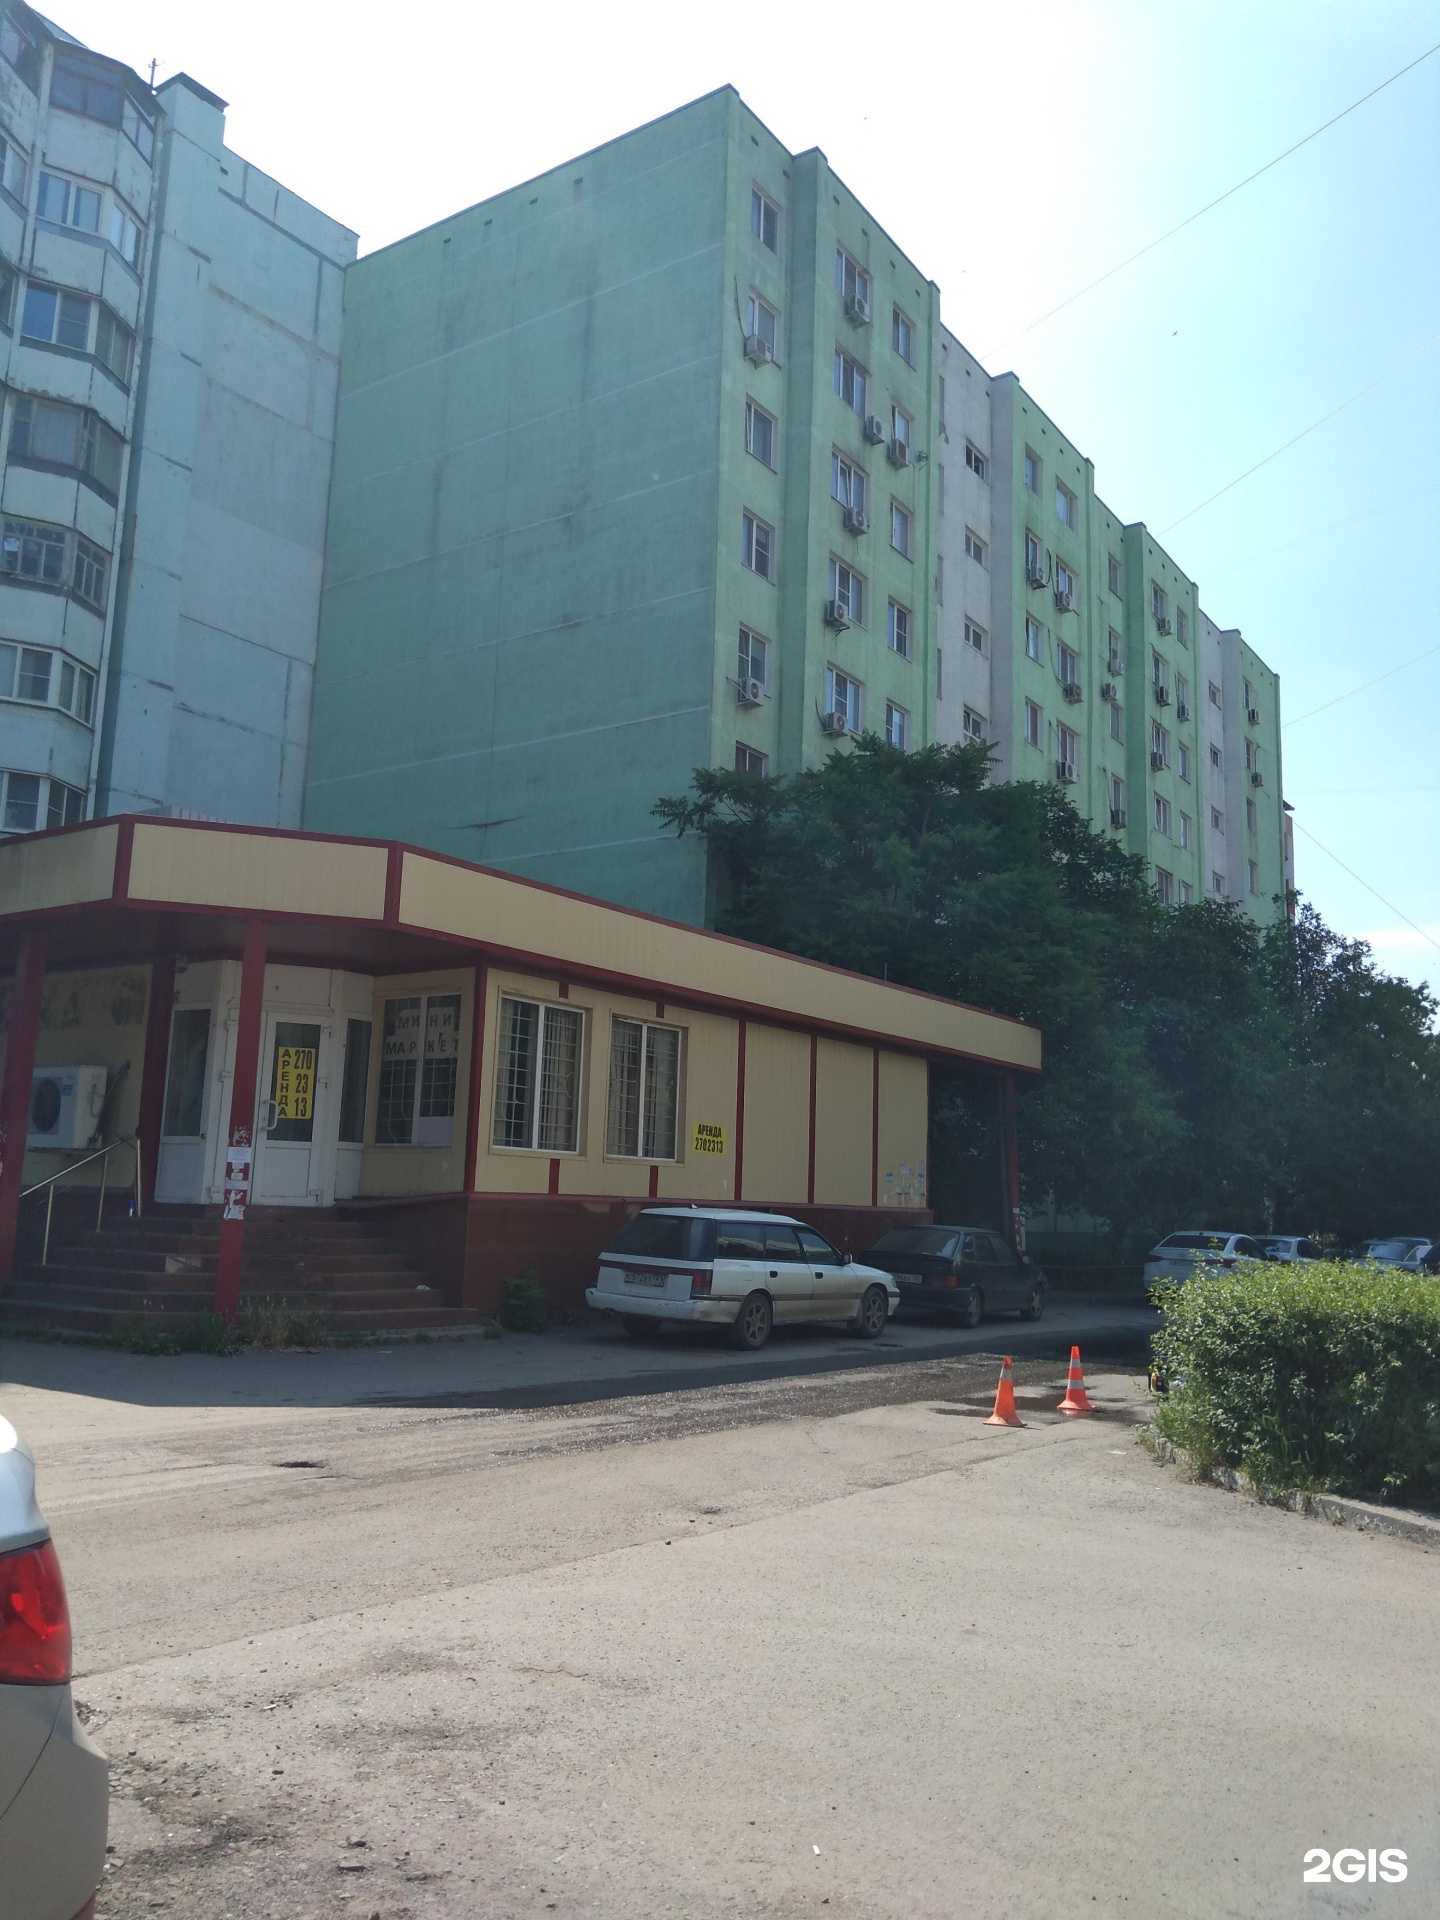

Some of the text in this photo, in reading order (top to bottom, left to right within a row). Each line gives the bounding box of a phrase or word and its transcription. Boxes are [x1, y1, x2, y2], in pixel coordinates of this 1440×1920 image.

[399, 1014, 452, 1029] МИНИ
[294, 1050, 312, 1069] 270
[278, 1049, 291, 1117] АРЕНДА
[296, 1073, 308, 1094] 23
[295, 1097, 307, 1117] 13
[698, 1124, 722, 1138] АРЕНДА
[695, 1137, 724, 1153] 2702313
